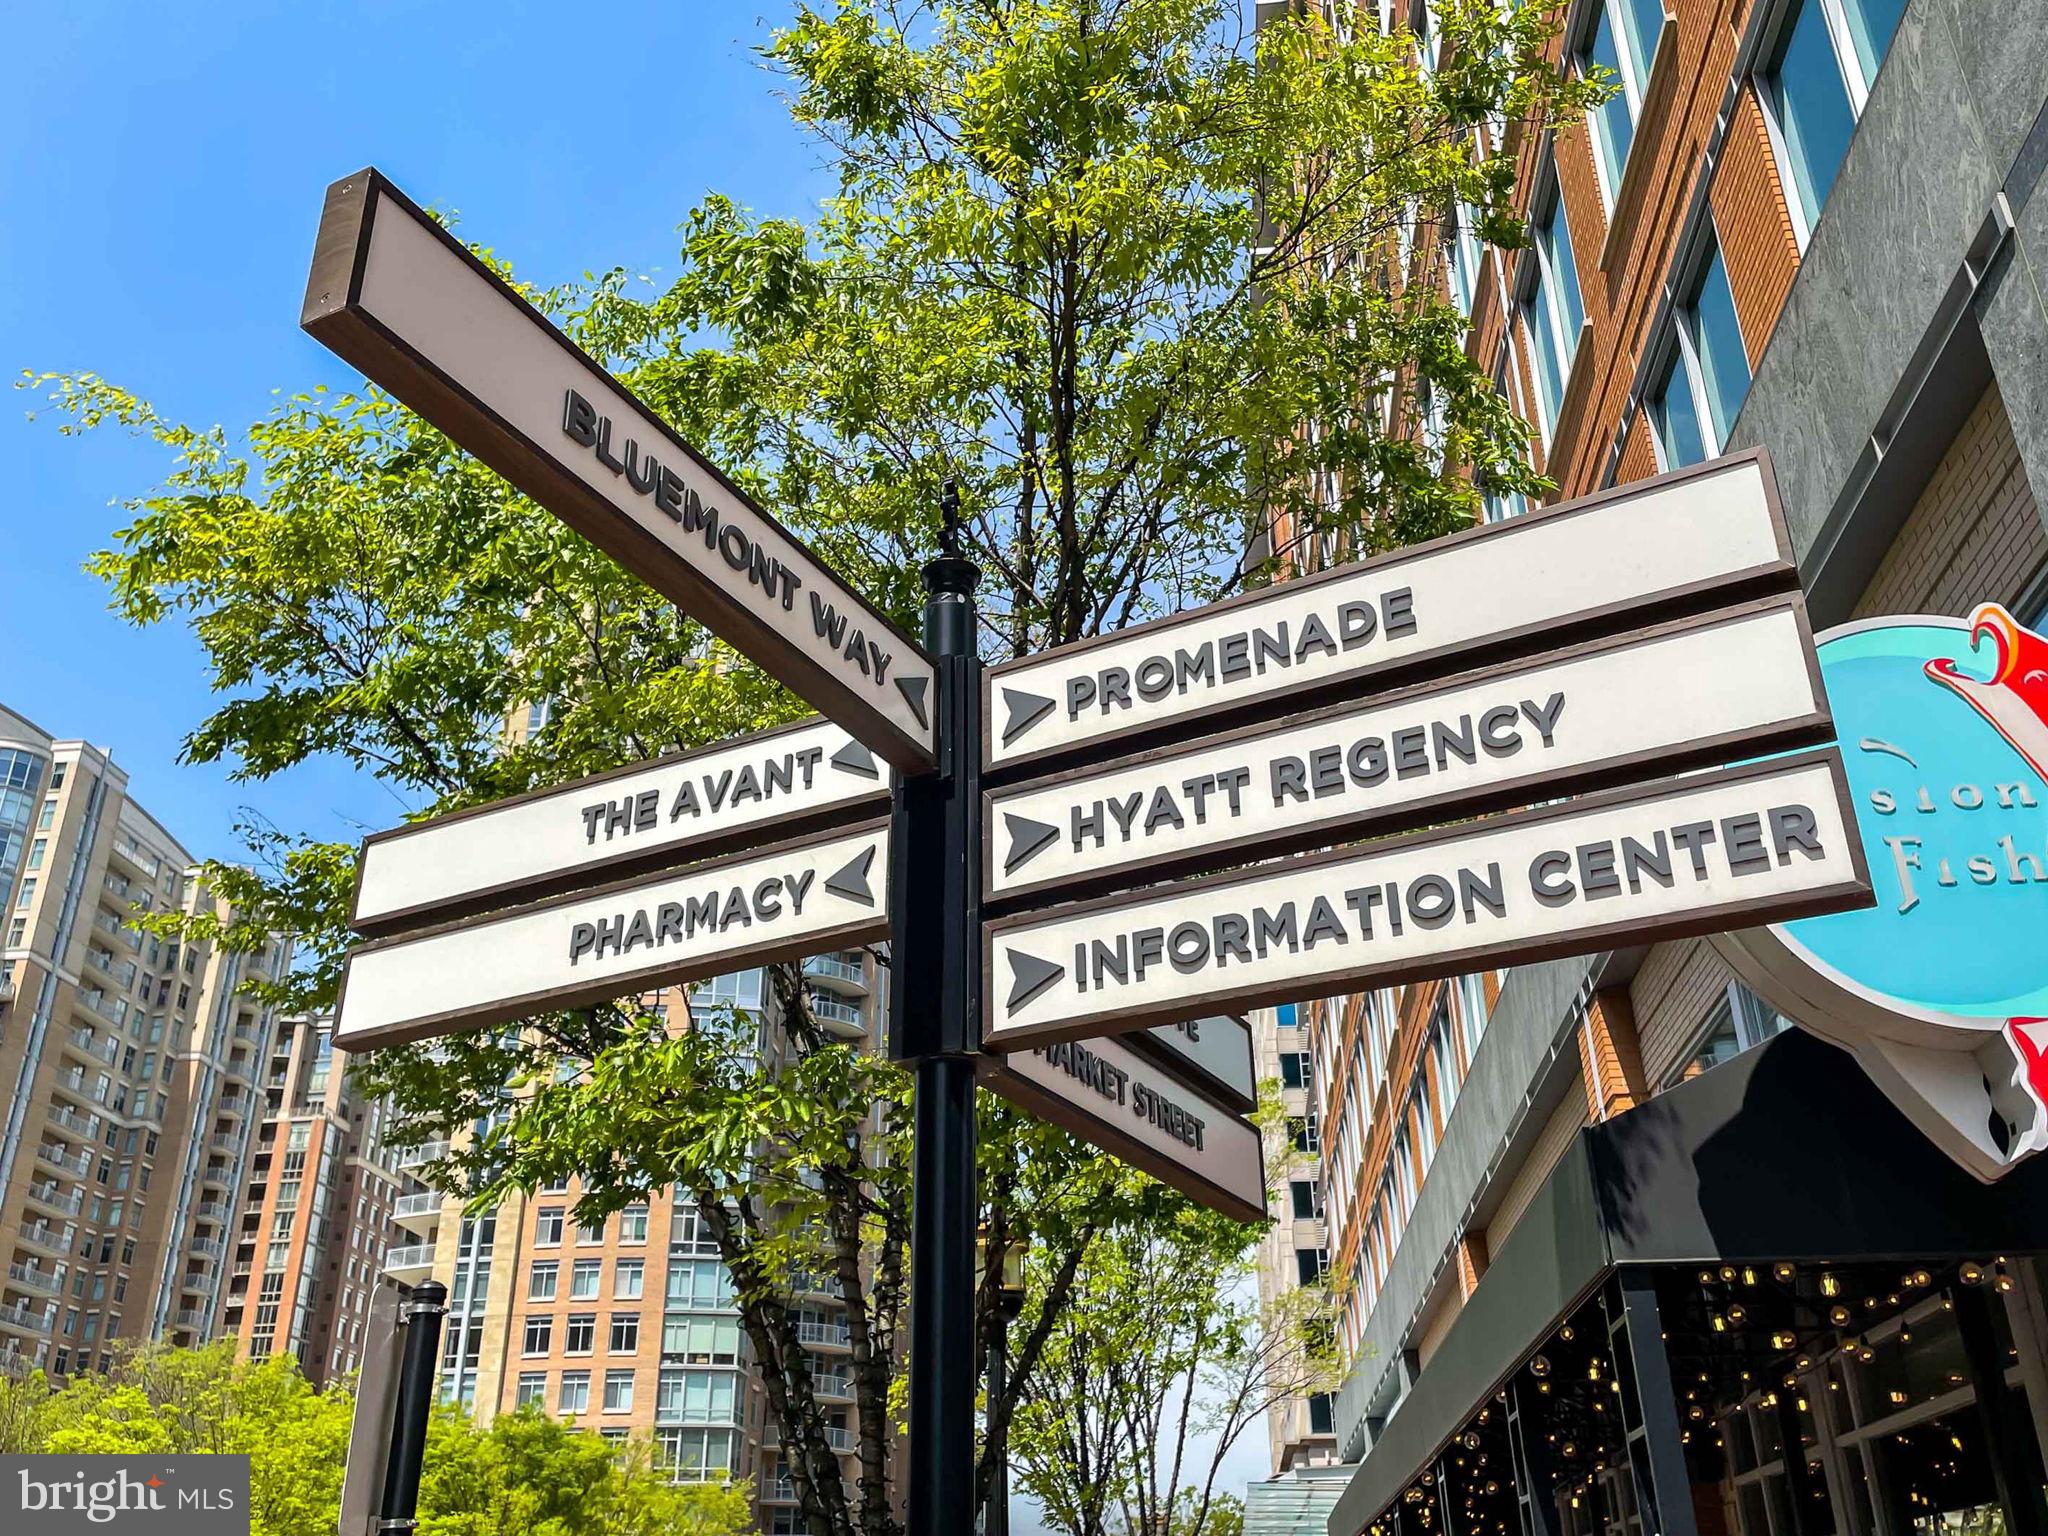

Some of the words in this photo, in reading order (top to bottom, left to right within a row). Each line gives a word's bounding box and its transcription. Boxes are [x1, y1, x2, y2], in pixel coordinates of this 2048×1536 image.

[563, 387, 802, 612] BLUEMONT
[810, 590, 893, 687] WAY
[1066, 586, 1417, 722] PROMENADE
[581, 789, 660, 845] THE
[669, 746, 823, 825] AVANT
[1070, 766, 1250, 853] HYATT
[1270, 691, 1566, 808] REGENCY
[569, 869, 816, 966] PHARMACY
[1074, 862, 1507, 993] INFORMATION
[1528, 804, 1825, 908] CENTER
[1882, 834, 2048, 915] Fish
[1133, 1081, 1206, 1152] STREET
